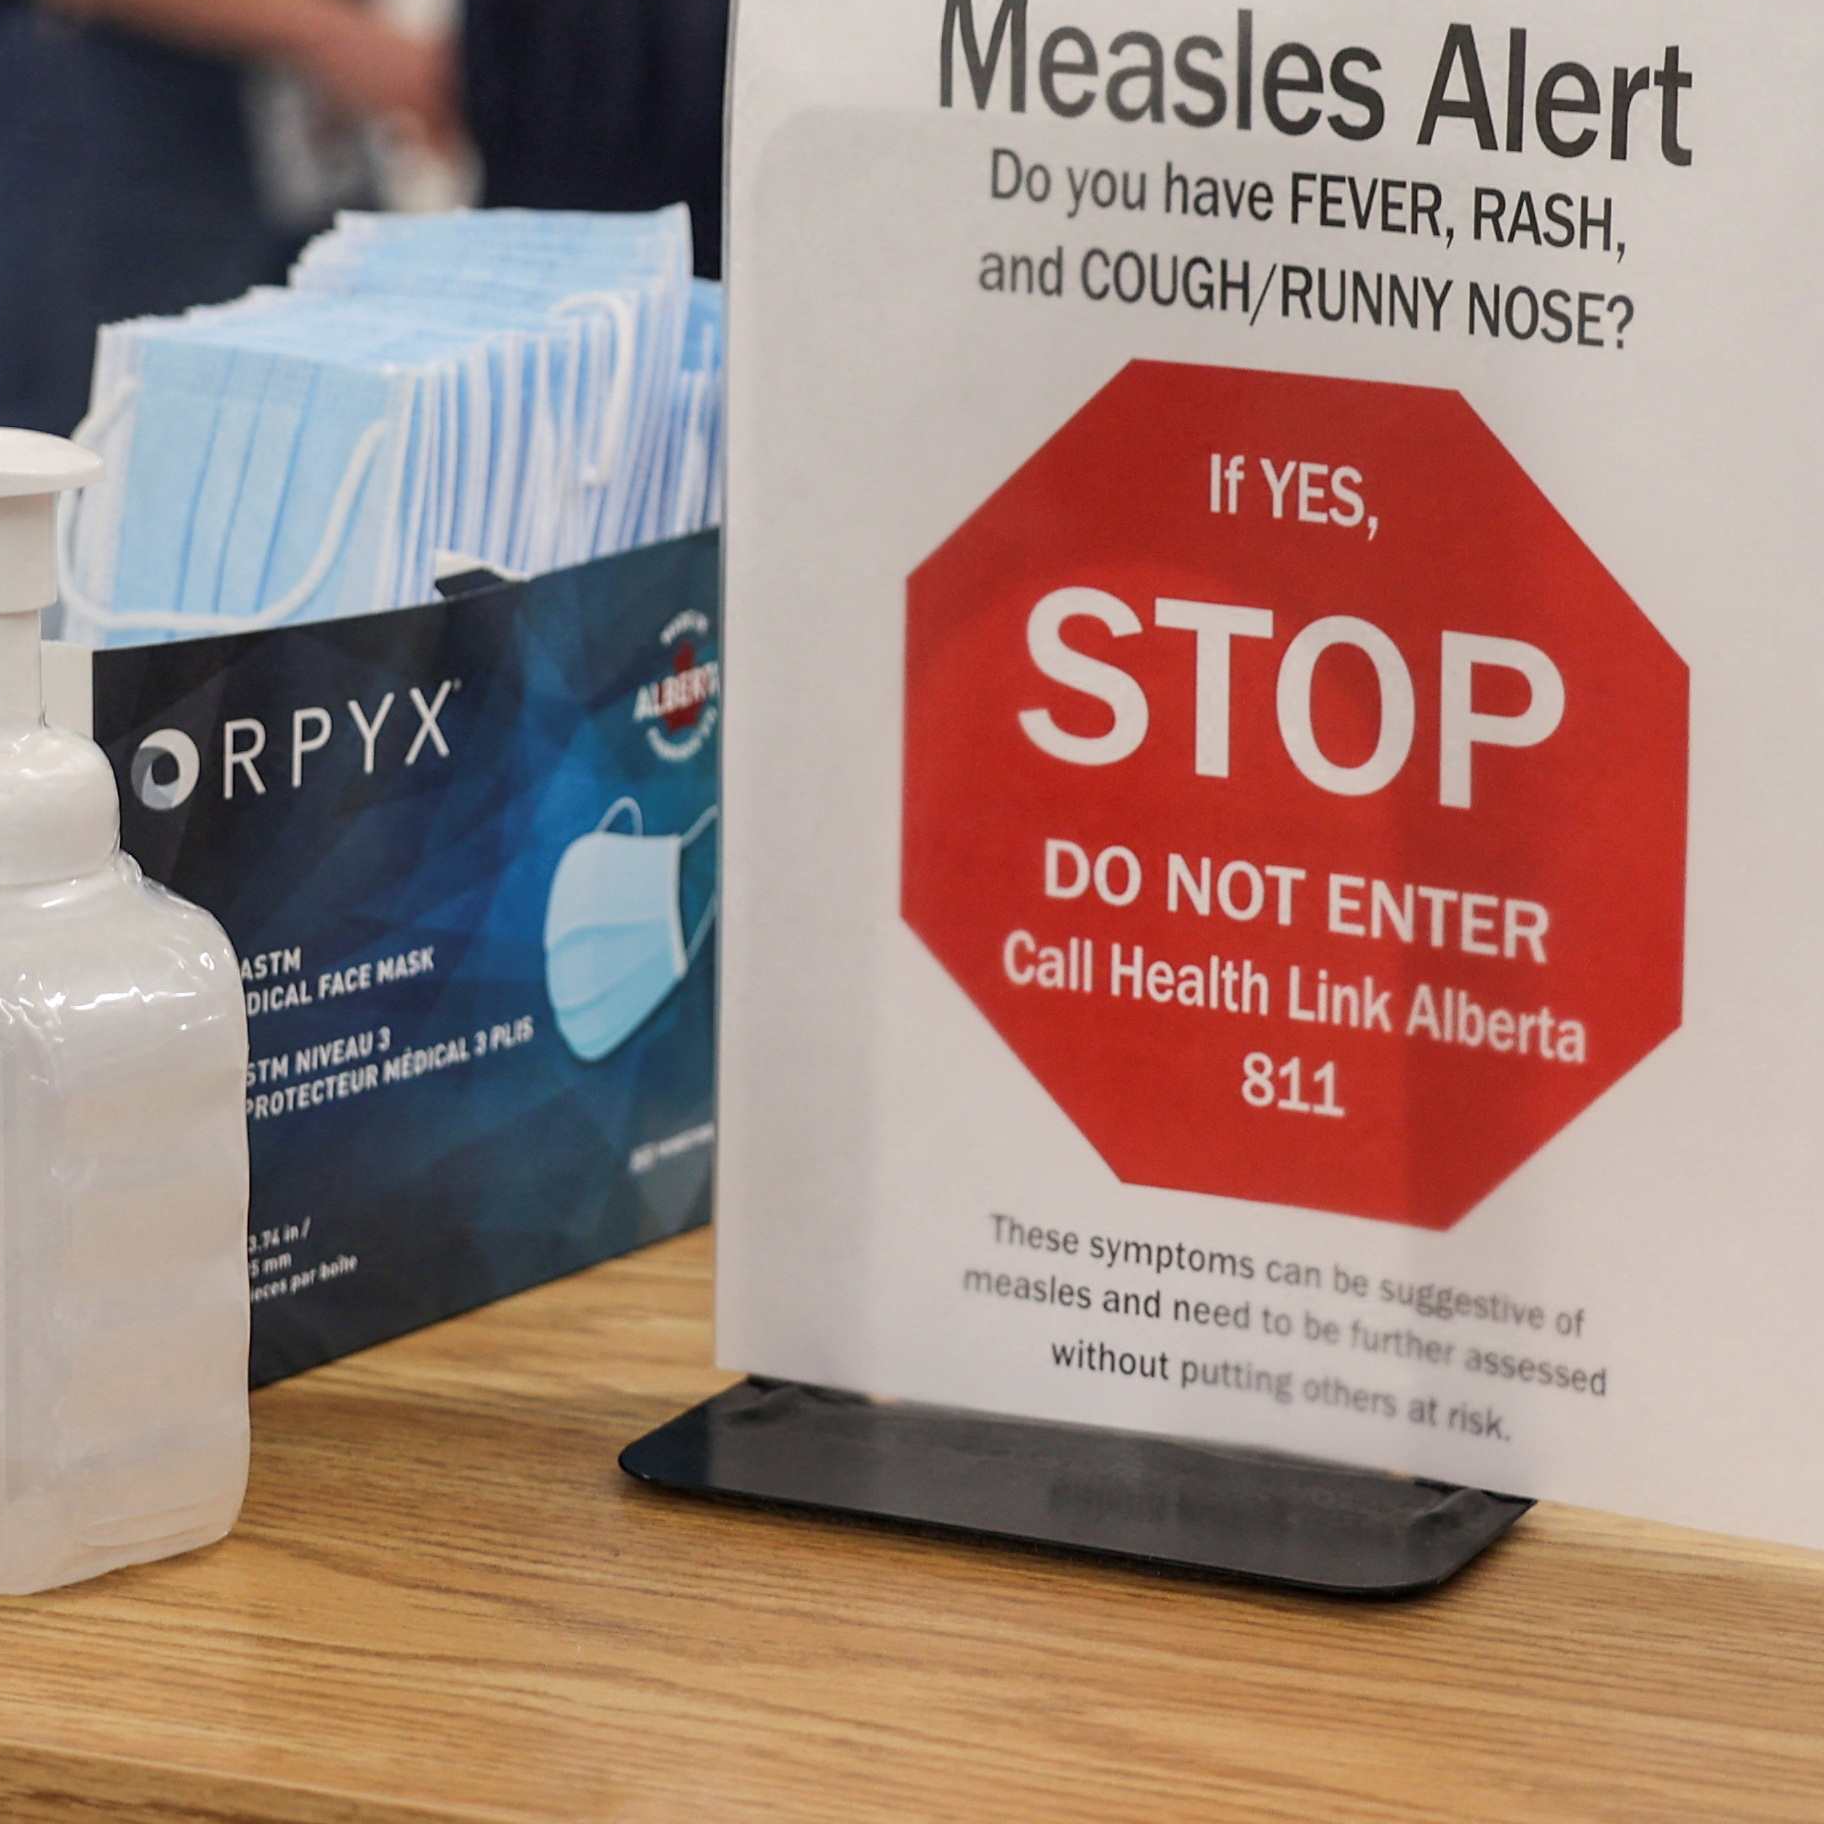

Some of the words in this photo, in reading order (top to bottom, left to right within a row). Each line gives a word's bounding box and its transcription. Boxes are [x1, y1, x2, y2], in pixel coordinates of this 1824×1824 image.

[1416, 22, 1695, 168] Alert
[989, 147, 1052, 206] Do
[1065, 164, 1148, 219] you
[1163, 161, 1275, 224] have
[1288, 172, 1457, 246] FEVER,
[1471, 189, 1628, 262] RASH,
[977, 247, 1065, 300] and
[1080, 248, 1455, 338] COUGH/RUNNY
[1468, 282, 1636, 351] NOSE?
[1209, 453, 1245, 514] If
[1260, 457, 1379, 542] YES,
[1017, 585, 1567, 811] STOP
[1043, 838, 1143, 908] DO
[1166, 852, 1306, 927] NOT
[1327, 873, 1551, 965] ENTER
[240, 946, 302, 982] ASTM
[246, 979, 313, 1017] DICAL
[317, 962, 373, 1000] FACE
[376, 945, 435, 985] MASK
[1003, 929, 1093, 993] Call
[1110, 942, 1270, 1017] Health
[1287, 966, 1394, 1035] Link
[1405, 983, 1588, 1064] Alberta
[246, 1054, 290, 1088] STM
[294, 1030, 375, 1076] NIVEAU
[377, 1026, 392, 1053] 3
[382, 1036, 470, 1084] MÉDICAL
[473, 1030, 488, 1057] 3
[489, 1014, 534, 1052] PLIS
[1240, 1051, 1346, 1119] 811
[989, 1212, 1081, 1257] These
[1088, 1234, 1255, 1281] symptoms
[1265, 1257, 1323, 1289] can
[1332, 1264, 1370, 1299] be
[1379, 1275, 1546, 1331] suggestive
[1555, 1307, 1586, 1339] of
[962, 1266, 1092, 1310] measles
[1102, 1283, 1162, 1319] and
[1172, 1294, 1251, 1331] need
[1261, 1306, 1294, 1337] to
[1303, 1308, 1341, 1345] be
[1350, 1318, 1456, 1367] further
[1463, 1344, 1608, 1398] assessed
[1050, 1339, 1170, 1381] without
[1179, 1358, 1294, 1404] putting
[1302, 1379, 1398, 1420] others
[1406, 1398, 1439, 1428] at
[1447, 1404, 1512, 1443] risk.
